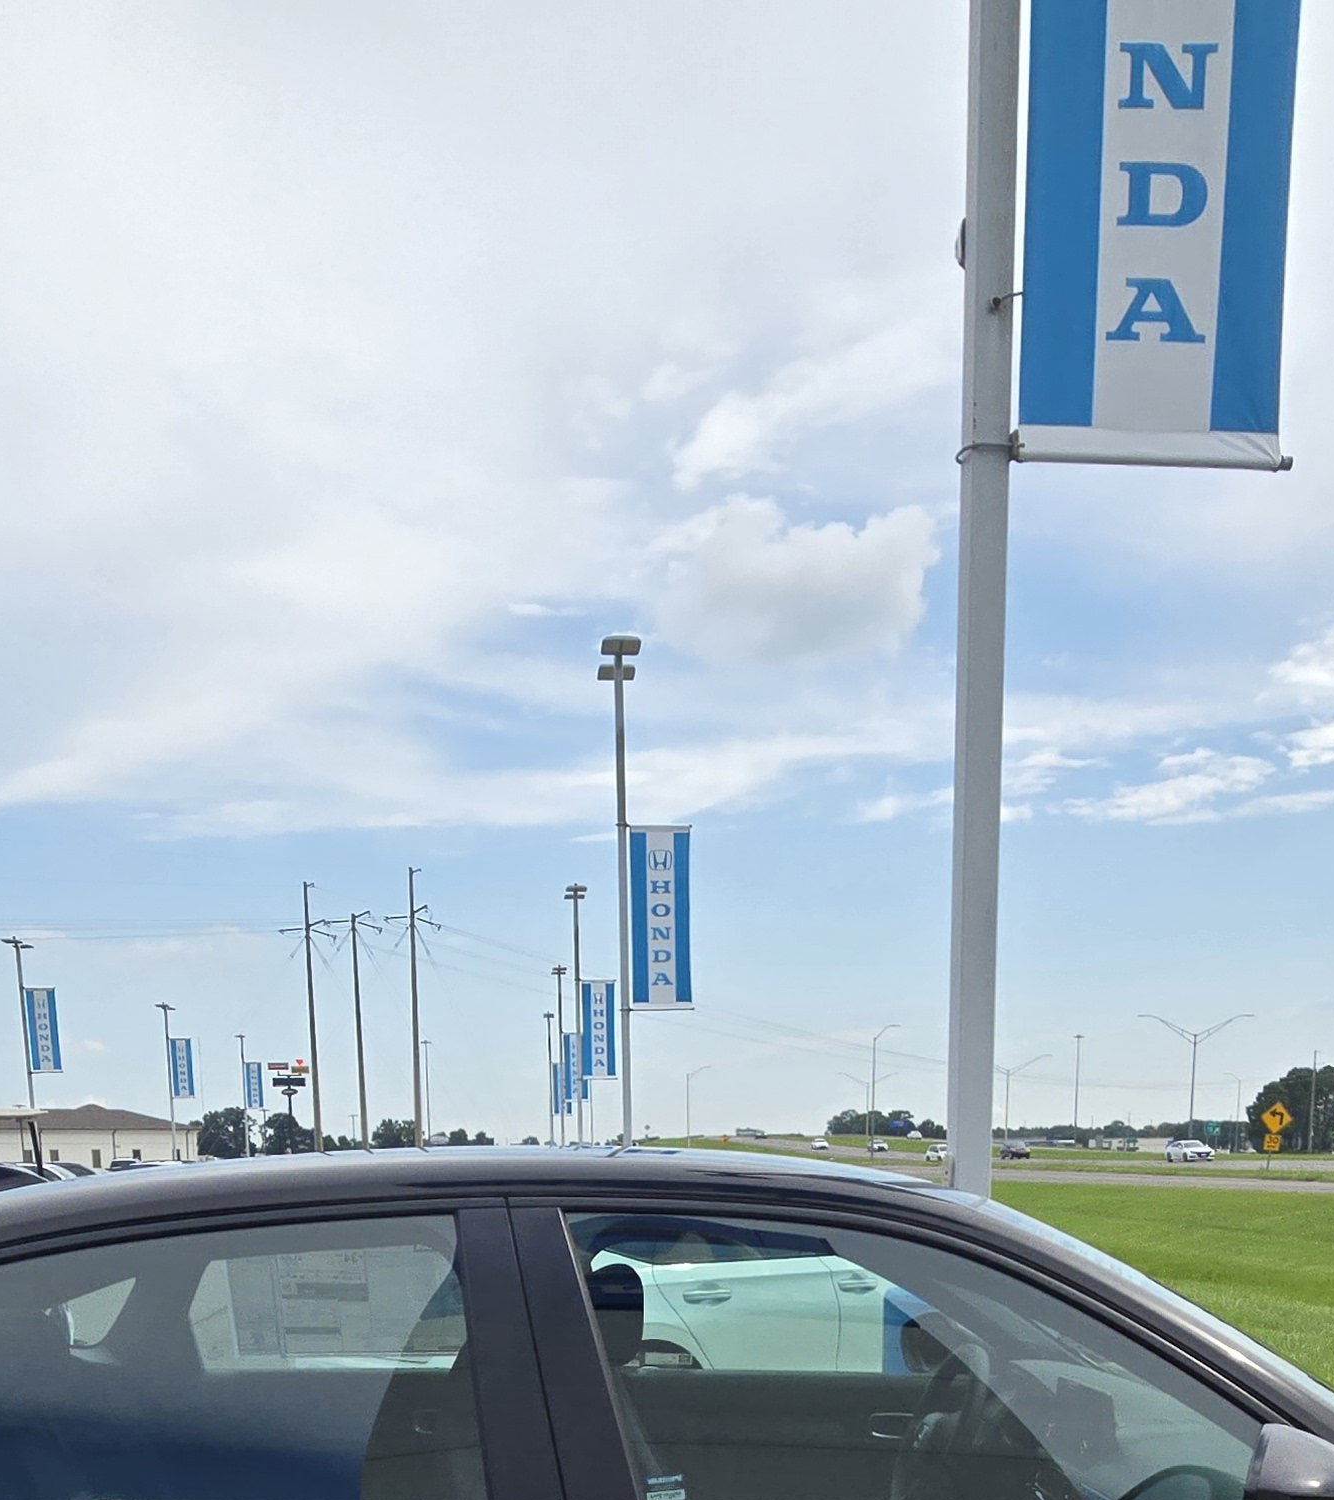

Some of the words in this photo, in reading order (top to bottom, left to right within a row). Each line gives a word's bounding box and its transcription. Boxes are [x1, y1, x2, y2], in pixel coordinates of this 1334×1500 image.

[650, 880, 674, 986] HONDA
[37, 1013, 52, 1063] HONDA
[593, 1009, 605, 1067] HONDA
